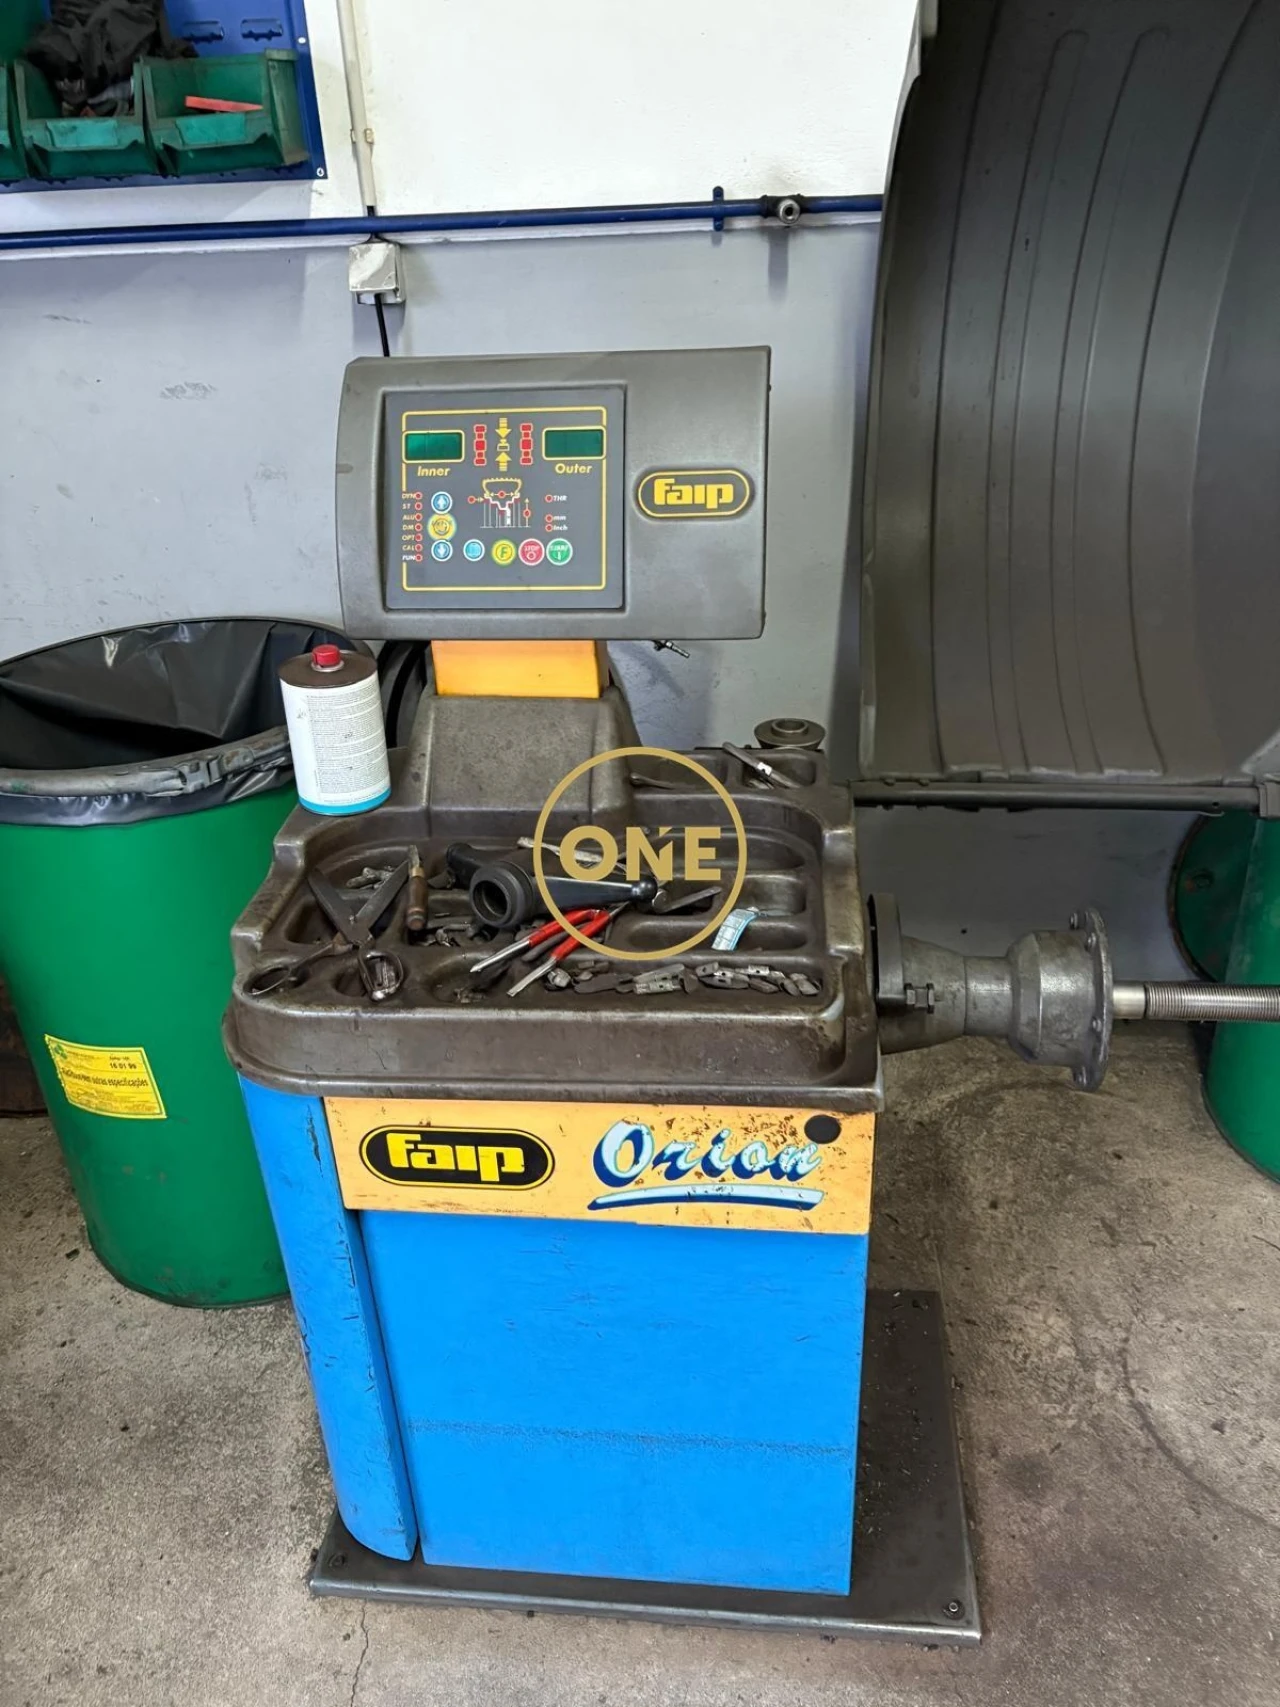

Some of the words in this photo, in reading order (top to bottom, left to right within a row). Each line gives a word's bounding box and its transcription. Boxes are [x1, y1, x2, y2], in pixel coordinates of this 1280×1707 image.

[417, 466, 451, 477] Inner
[555, 463, 593, 474] Outer
[593, 1121, 822, 1188] Orion
